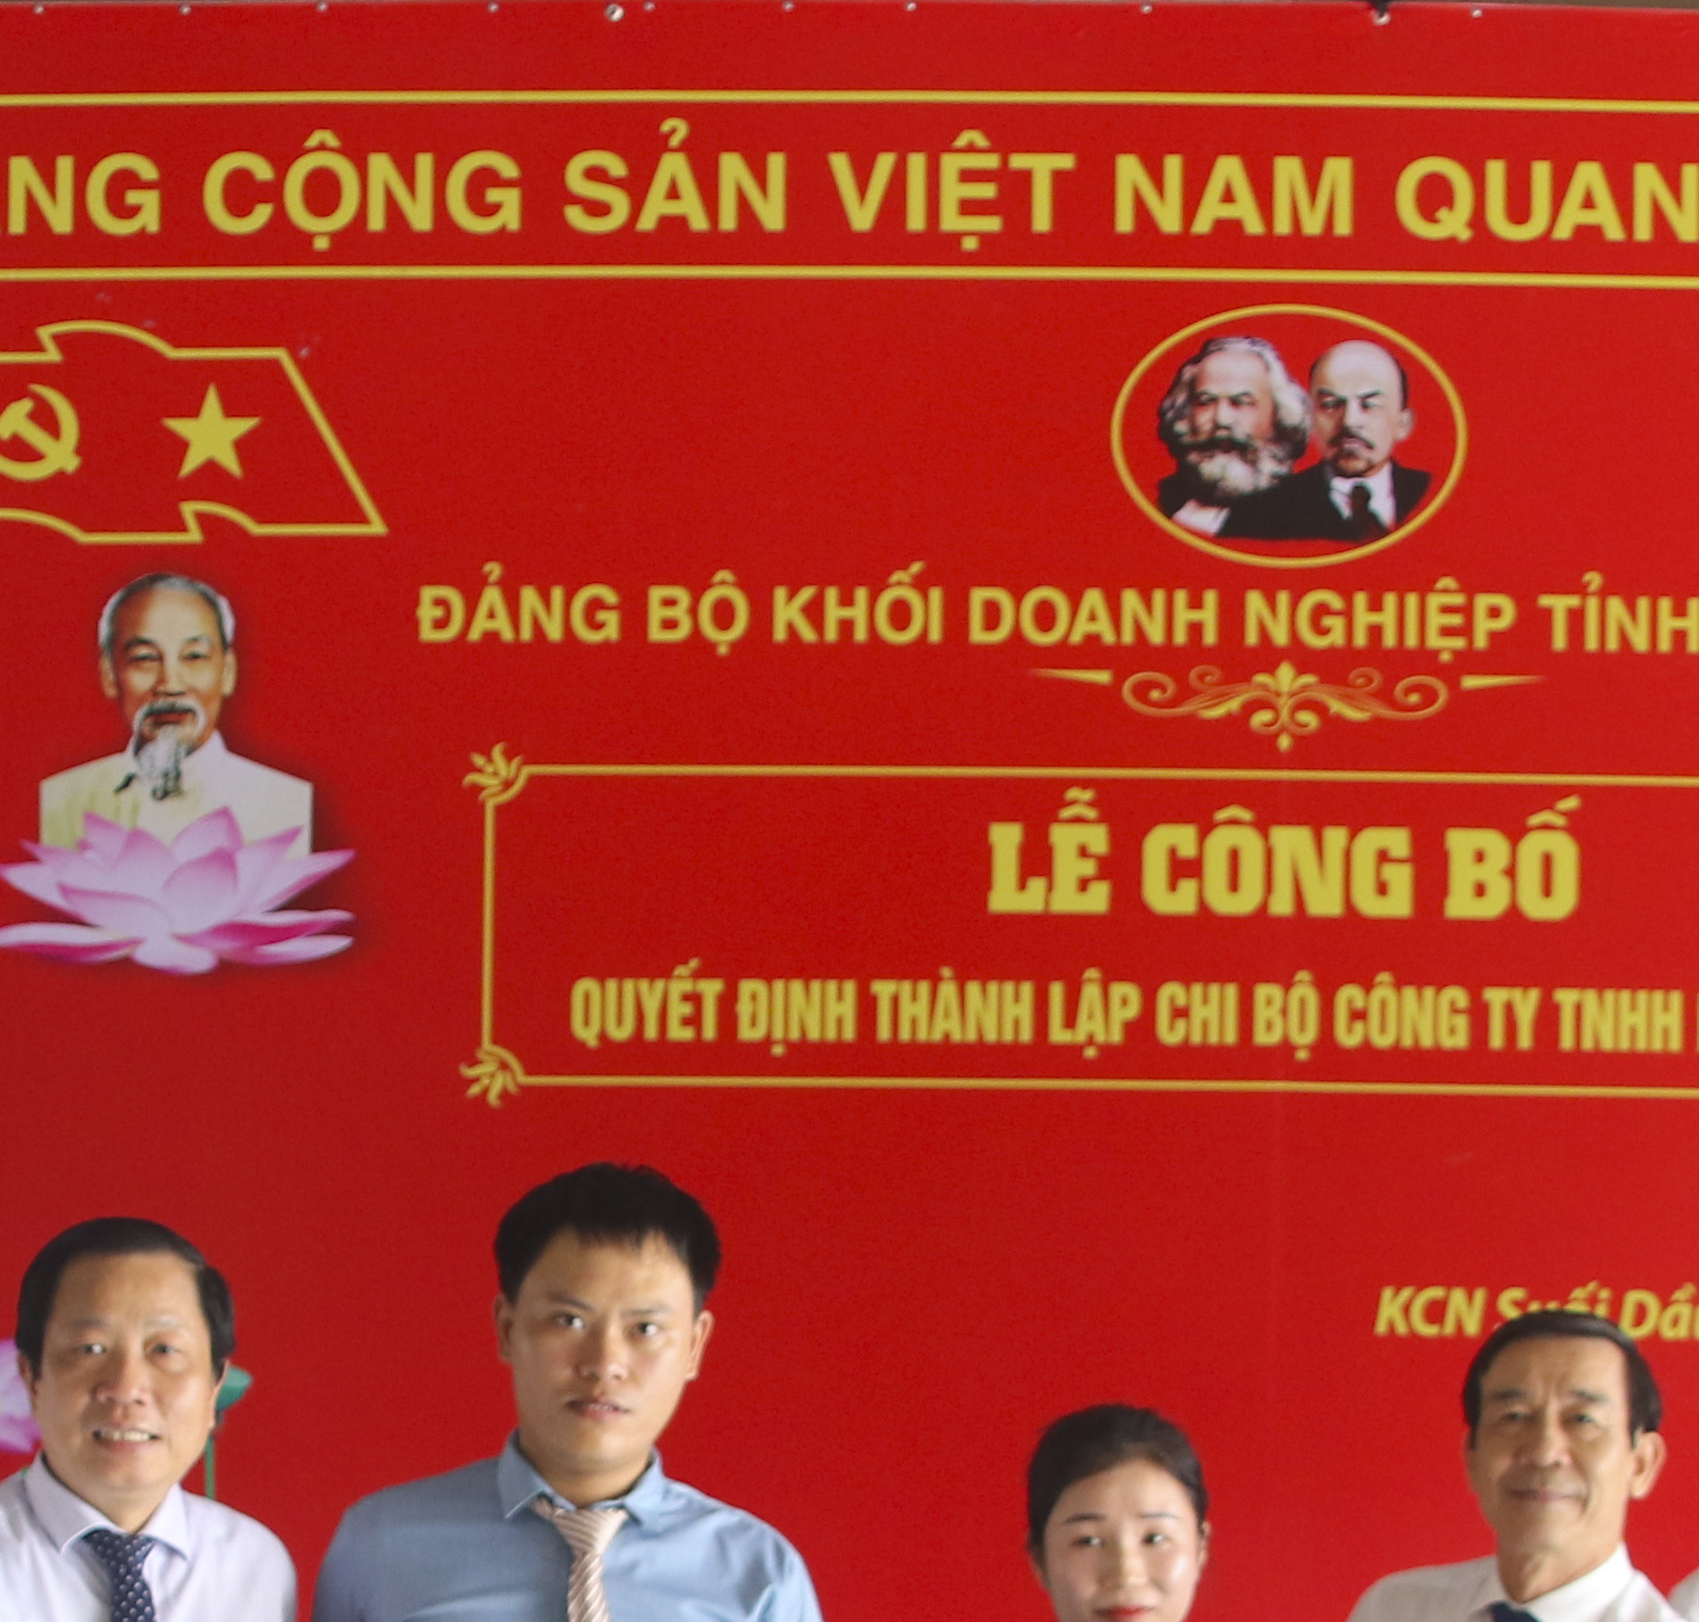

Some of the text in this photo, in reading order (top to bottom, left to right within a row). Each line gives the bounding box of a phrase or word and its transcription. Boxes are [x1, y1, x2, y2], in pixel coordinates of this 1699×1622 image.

[202, 128, 522, 251] CỘNG
[563, 116, 787, 235] SẢN
[827, 128, 1077, 252] VIỆT
[1114, 152, 1354, 239] NAM
[415, 561, 621, 644] ĐẢNG
[647, 569, 750, 656] BỘ
[772, 560, 944, 645] KHỐI
[968, 585, 1219, 647] DOANH
[1244, 576, 1517, 663] NGHIỆP
[987, 786, 1581, 922] LỄ CÔNG BỐ
[570, 958, 725, 1048] QUYẾT
[735, 978, 857, 1056] ĐỊNH
[869, 966, 1035, 1044] THÀNH
[1047, 967, 1143, 1059] LẬP
[1155, 980, 1239, 1047] CHI
[1252, 969, 1321, 1061] BỘ
[1333, 971, 1471, 1050] CÔNG
[1481, 986, 1541, 1051] TY
[1551, 987, 1685, 1054] TNHH
[1374, 1285, 1489, 1338] KCN
